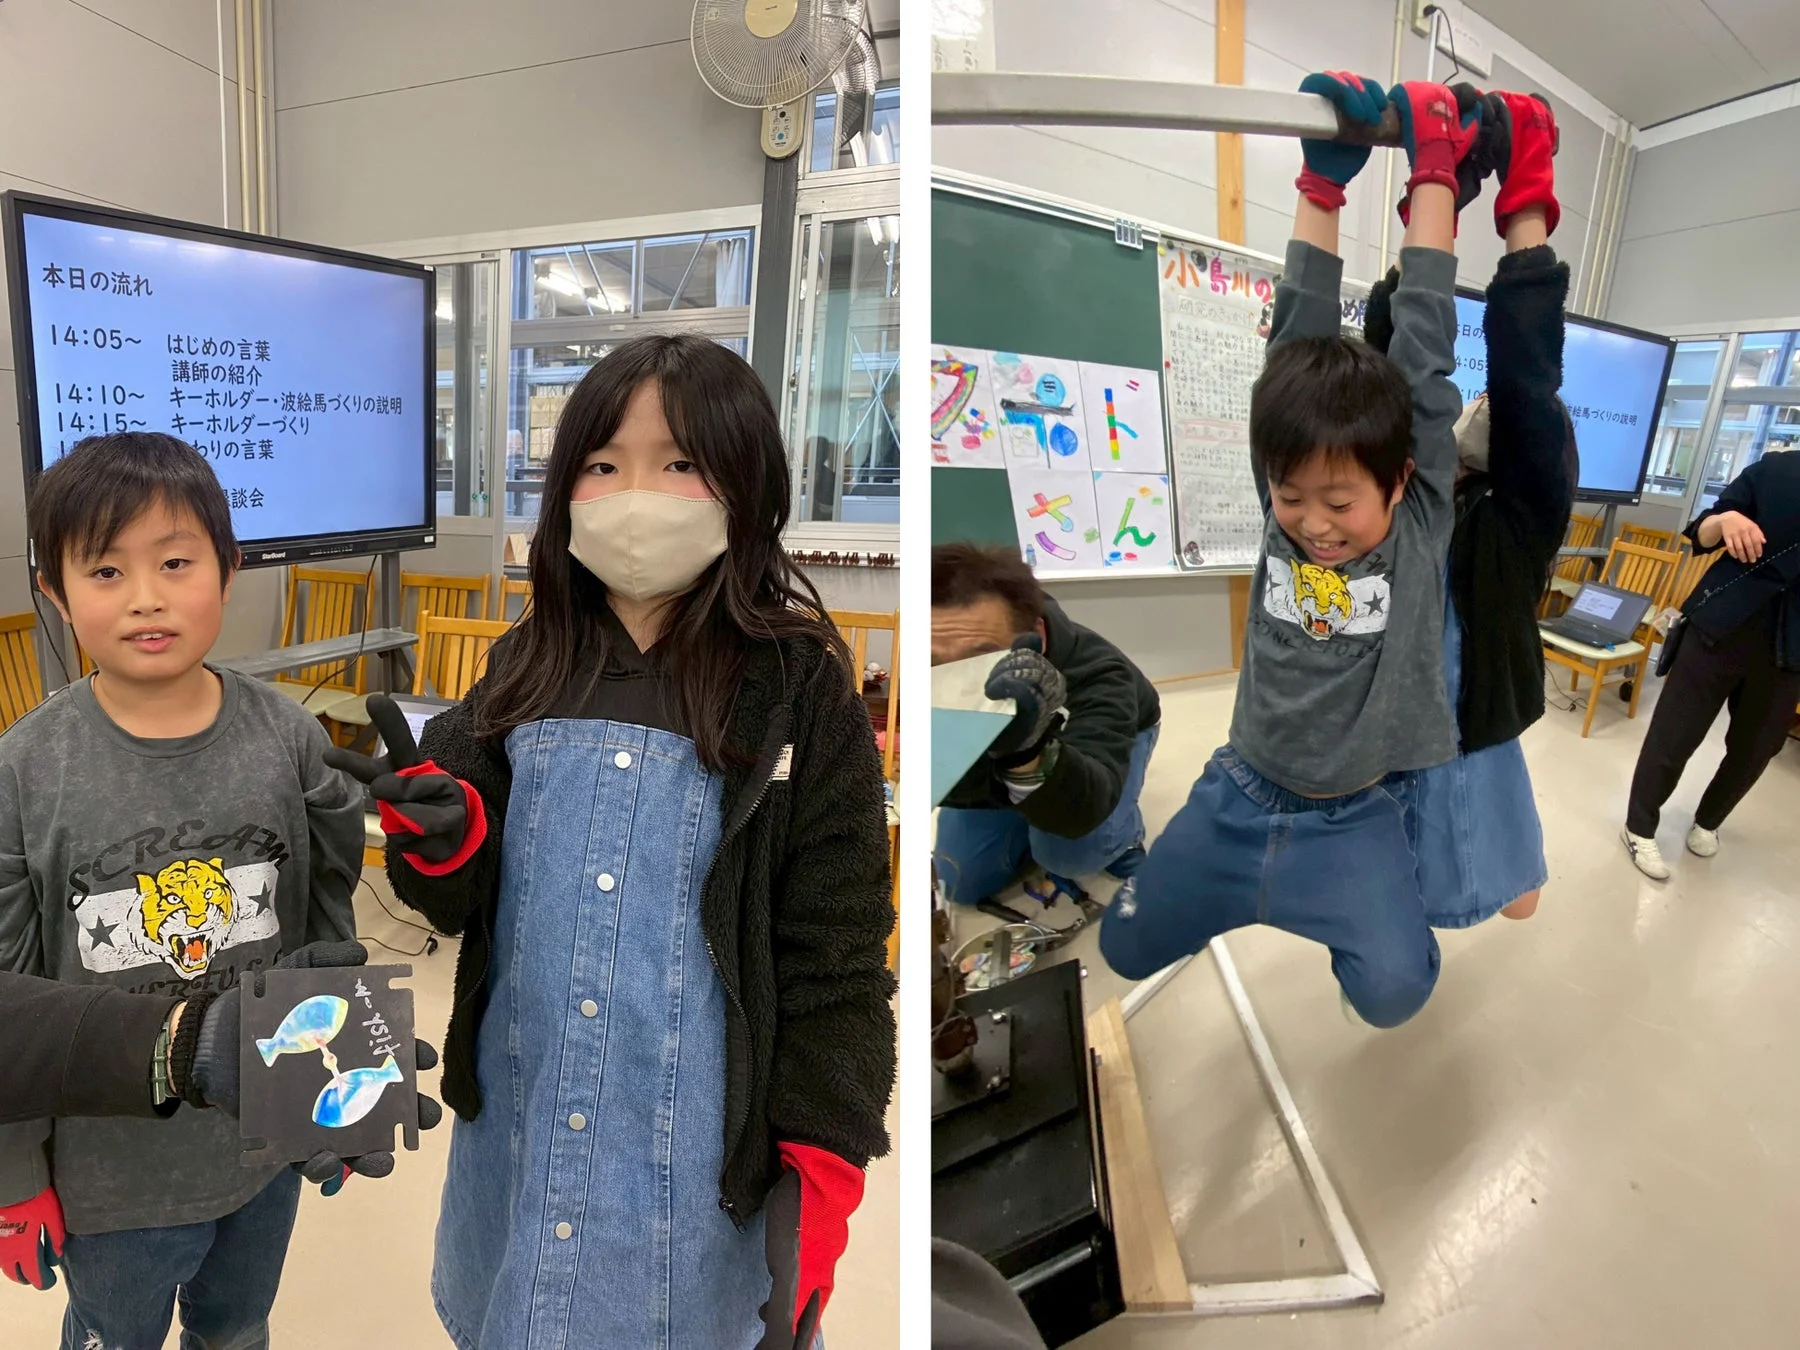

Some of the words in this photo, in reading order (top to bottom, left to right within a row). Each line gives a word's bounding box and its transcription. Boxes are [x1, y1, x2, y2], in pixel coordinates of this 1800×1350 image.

[42, 262, 153, 297] 本日の流れ
[167, 334, 271, 362] はじめの言葉
[171, 360, 263, 386] 講師の紹介
[170, 387, 402, 415] キーホルダー・波絵馬づくりの説明
[171, 413, 310, 435] キーホルダーづくり
[67, 819, 289, 912] SCREAM
